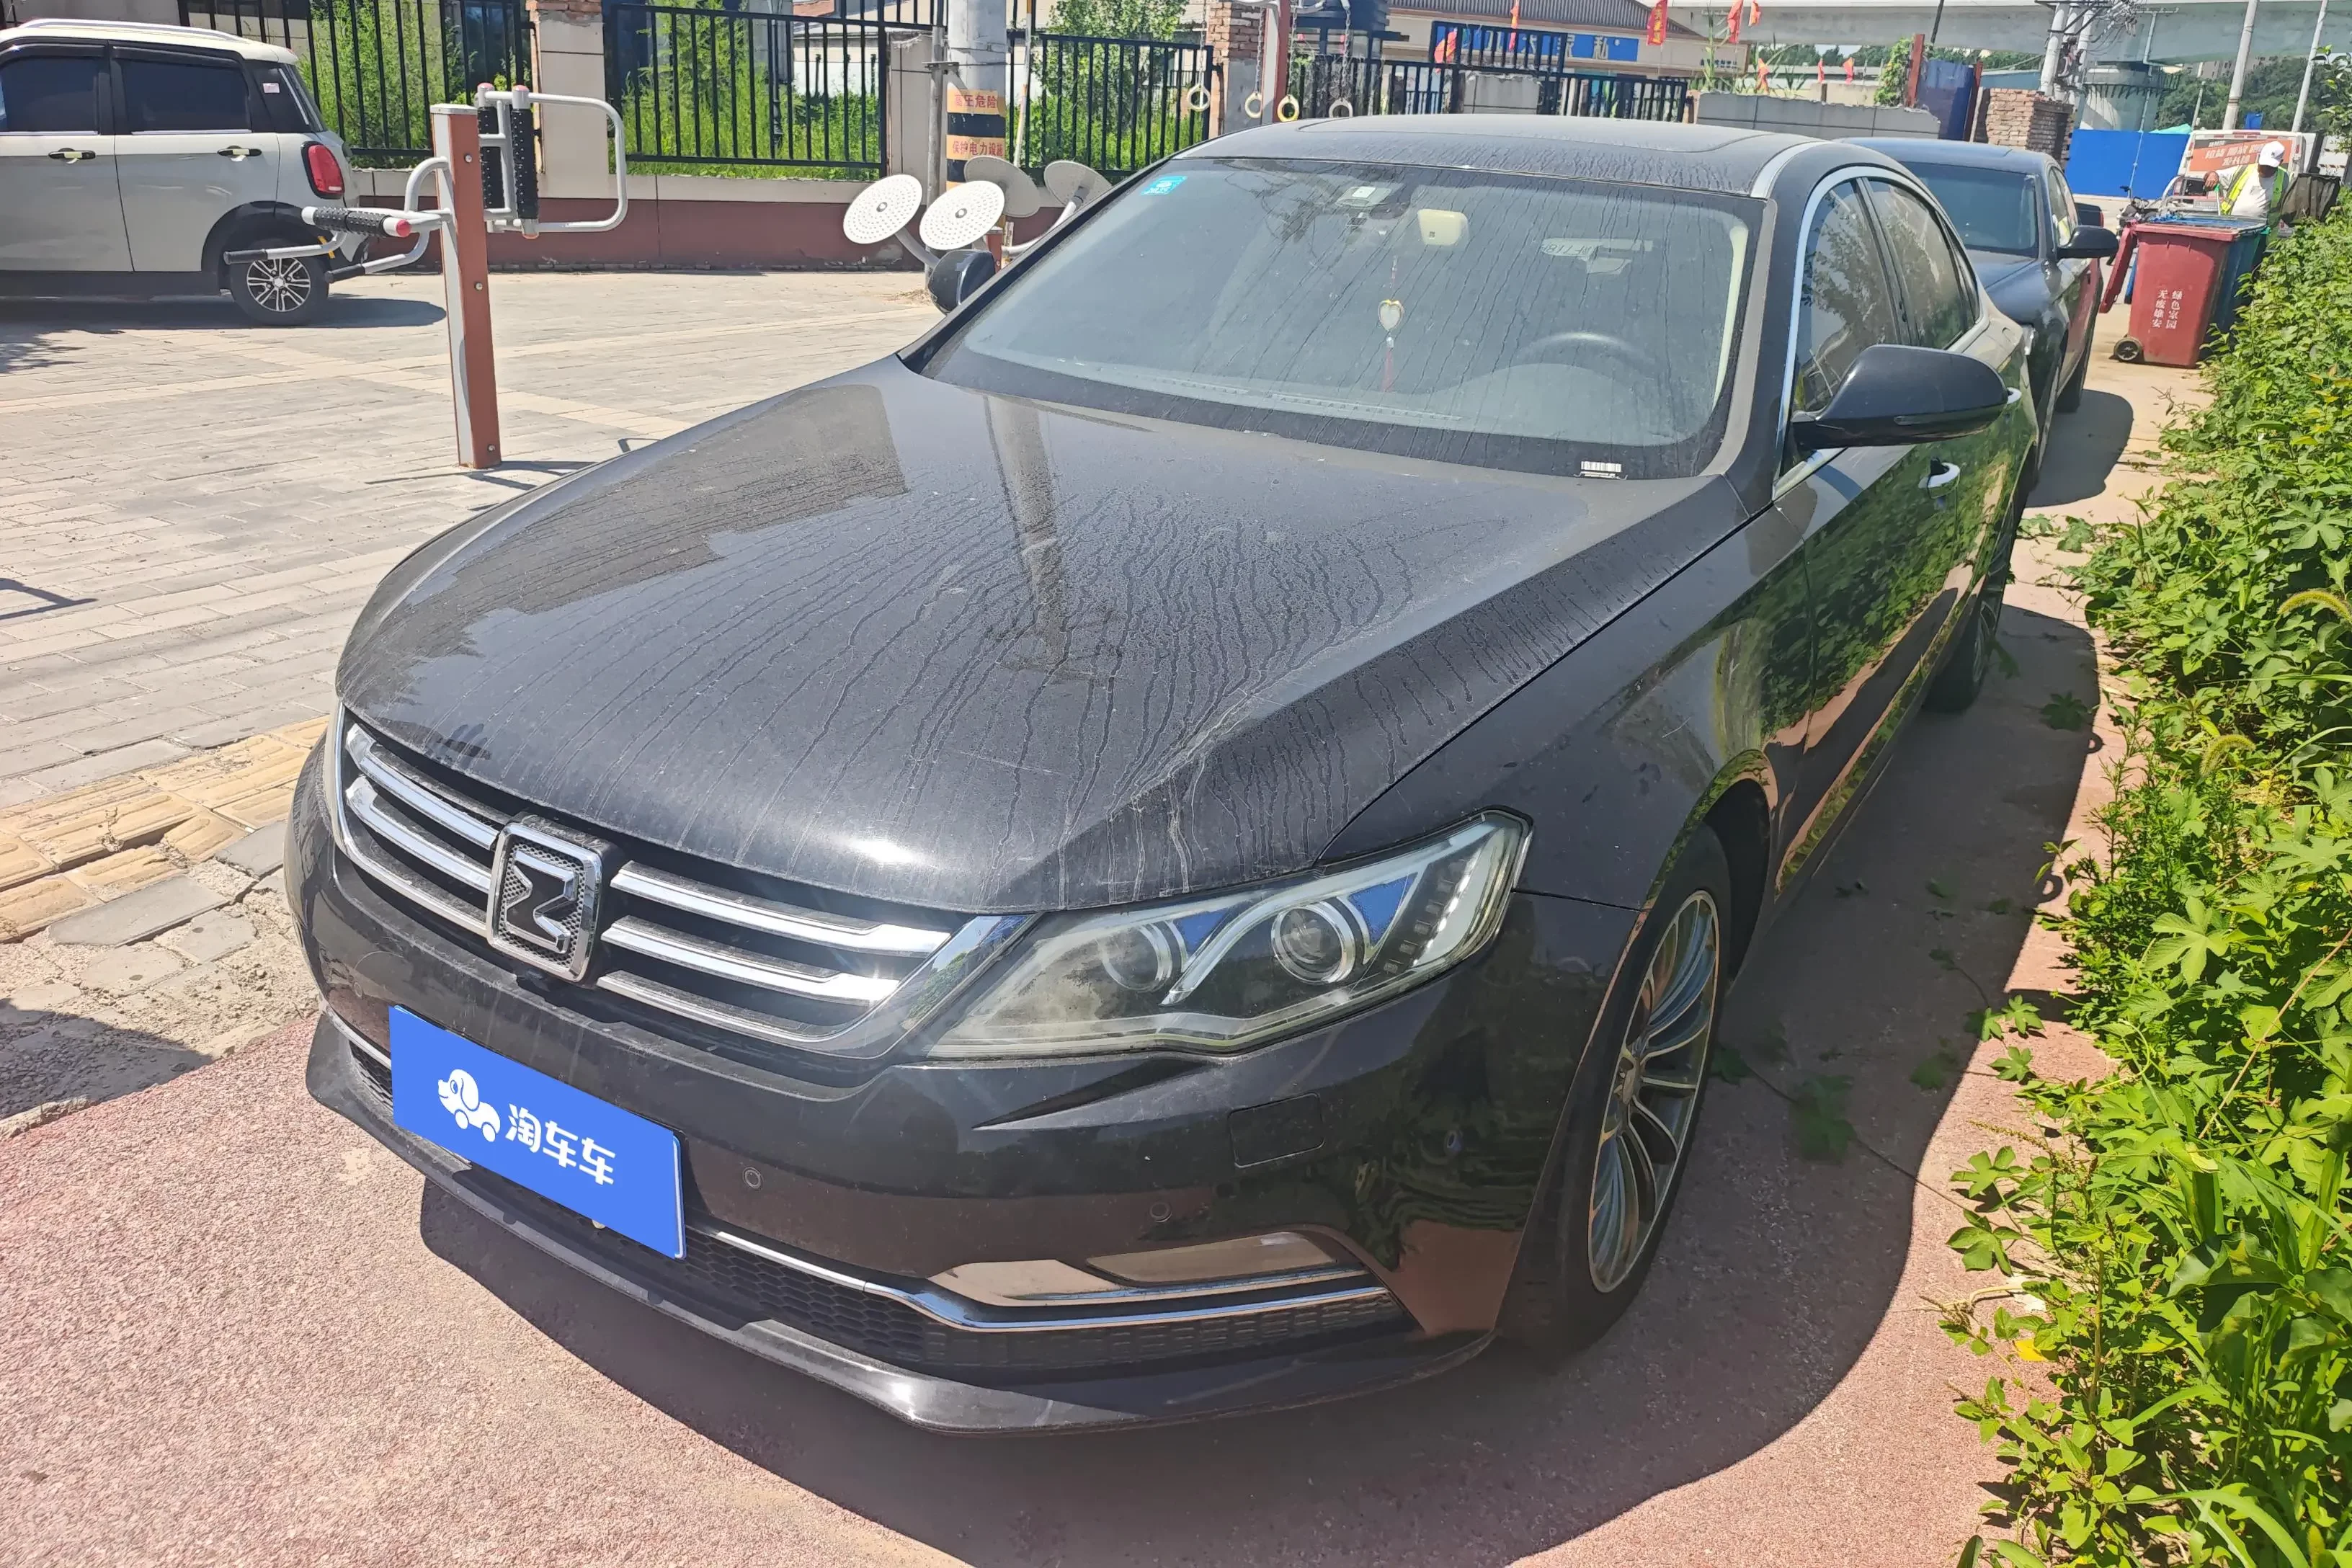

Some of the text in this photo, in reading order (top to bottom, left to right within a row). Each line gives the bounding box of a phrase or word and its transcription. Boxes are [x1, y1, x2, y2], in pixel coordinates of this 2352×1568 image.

[955, 94, 997, 108] 高压危险
[953, 141, 1003, 156] 保护电力设施
[2165, 290, 2183, 329] 绿色家园
